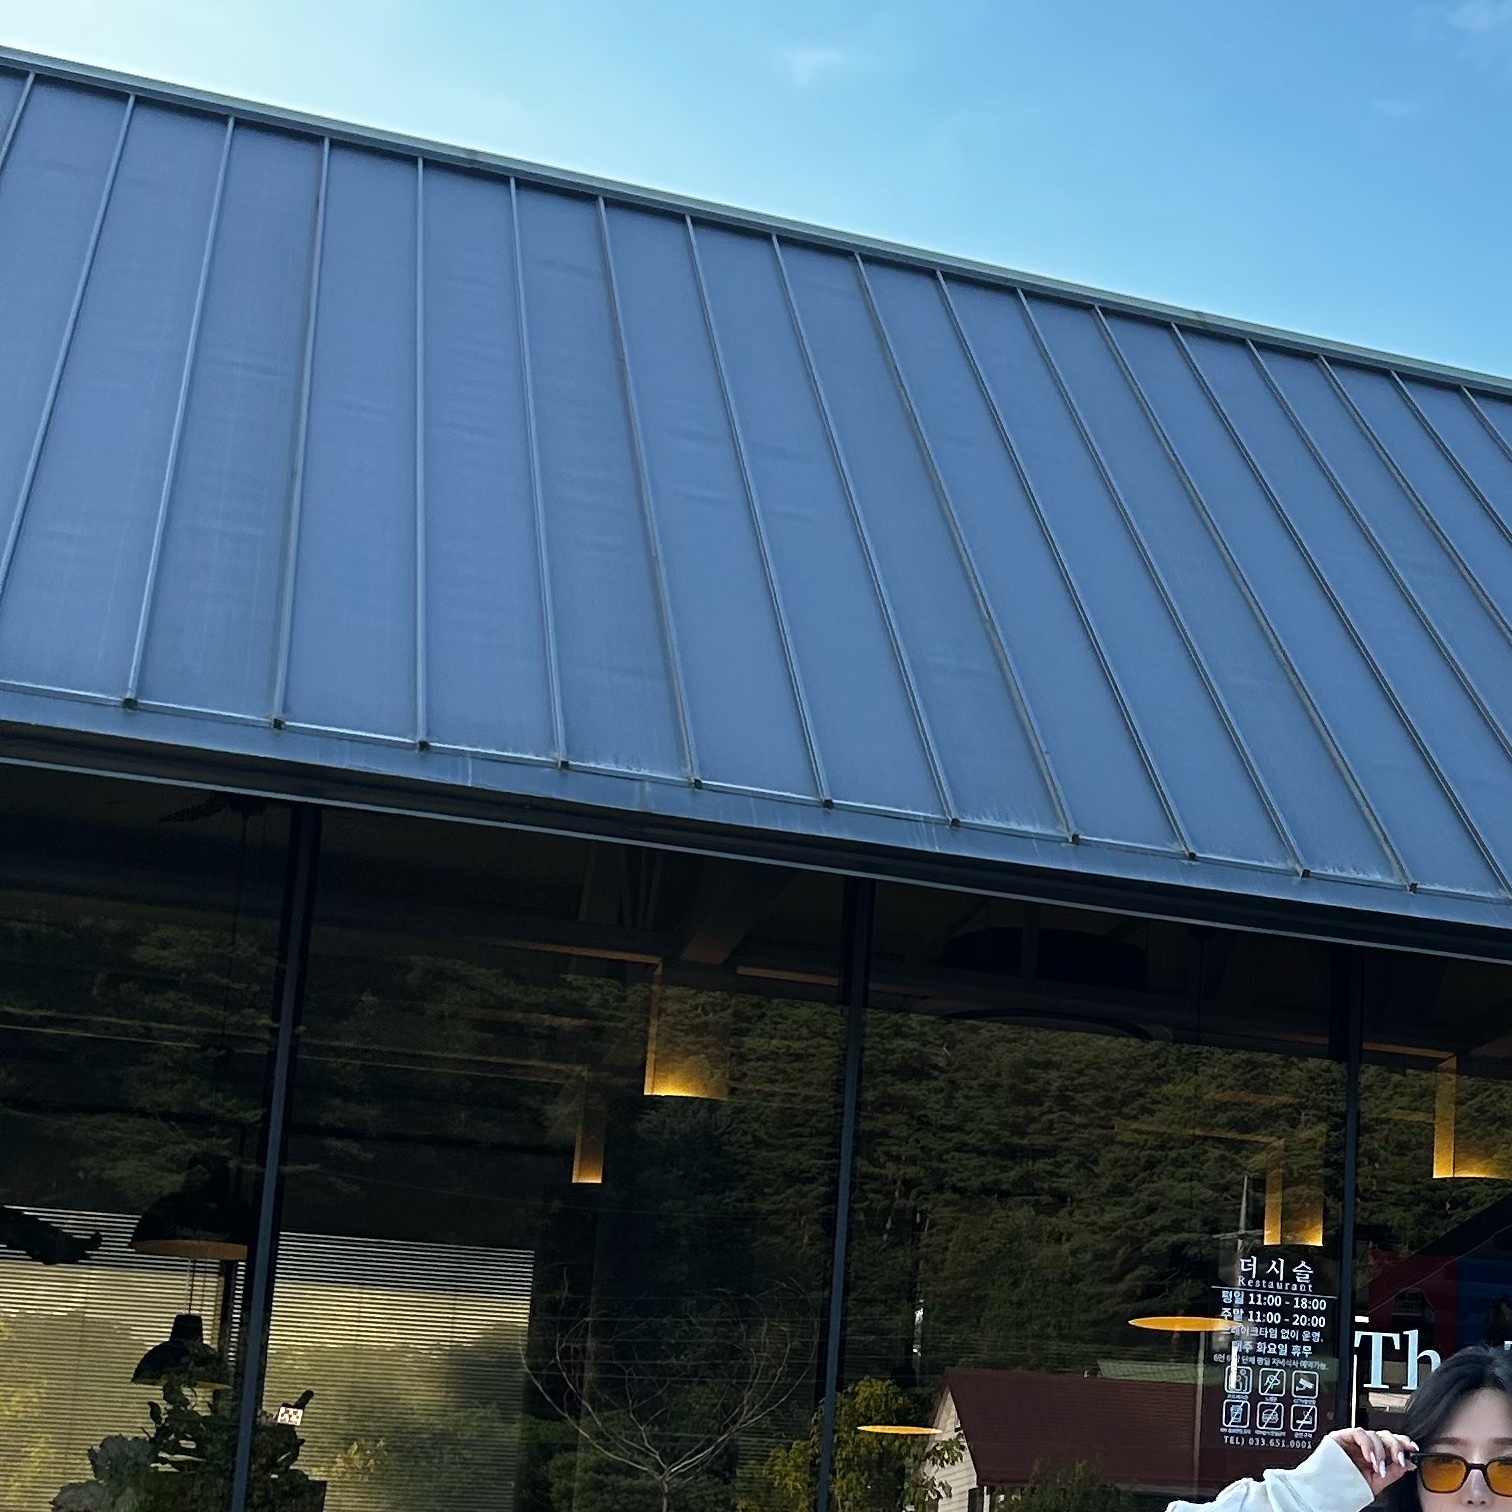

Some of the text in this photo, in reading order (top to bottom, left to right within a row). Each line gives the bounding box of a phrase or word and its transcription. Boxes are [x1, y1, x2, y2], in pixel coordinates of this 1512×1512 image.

[1237, 1275, 1313, 1293] Restaurant
[1221, 1290, 1245, 1305] 평일
[1248, 1293, 1282, 1307] 11:00
[1293, 1297, 1327, 1311] 18:00
[1221, 1307, 1245, 1321] 주말
[1247, 1310, 1282, 1324] 11:00
[1292, 1314, 1326, 1328] 20:00
[1256, 1341, 1288, 1356] 화요일
[1291, 1344, 1313, 1358] 휴무
[1354, 1329, 1441, 1390] Th
[1223, 1435, 1245, 1447] TEL)
